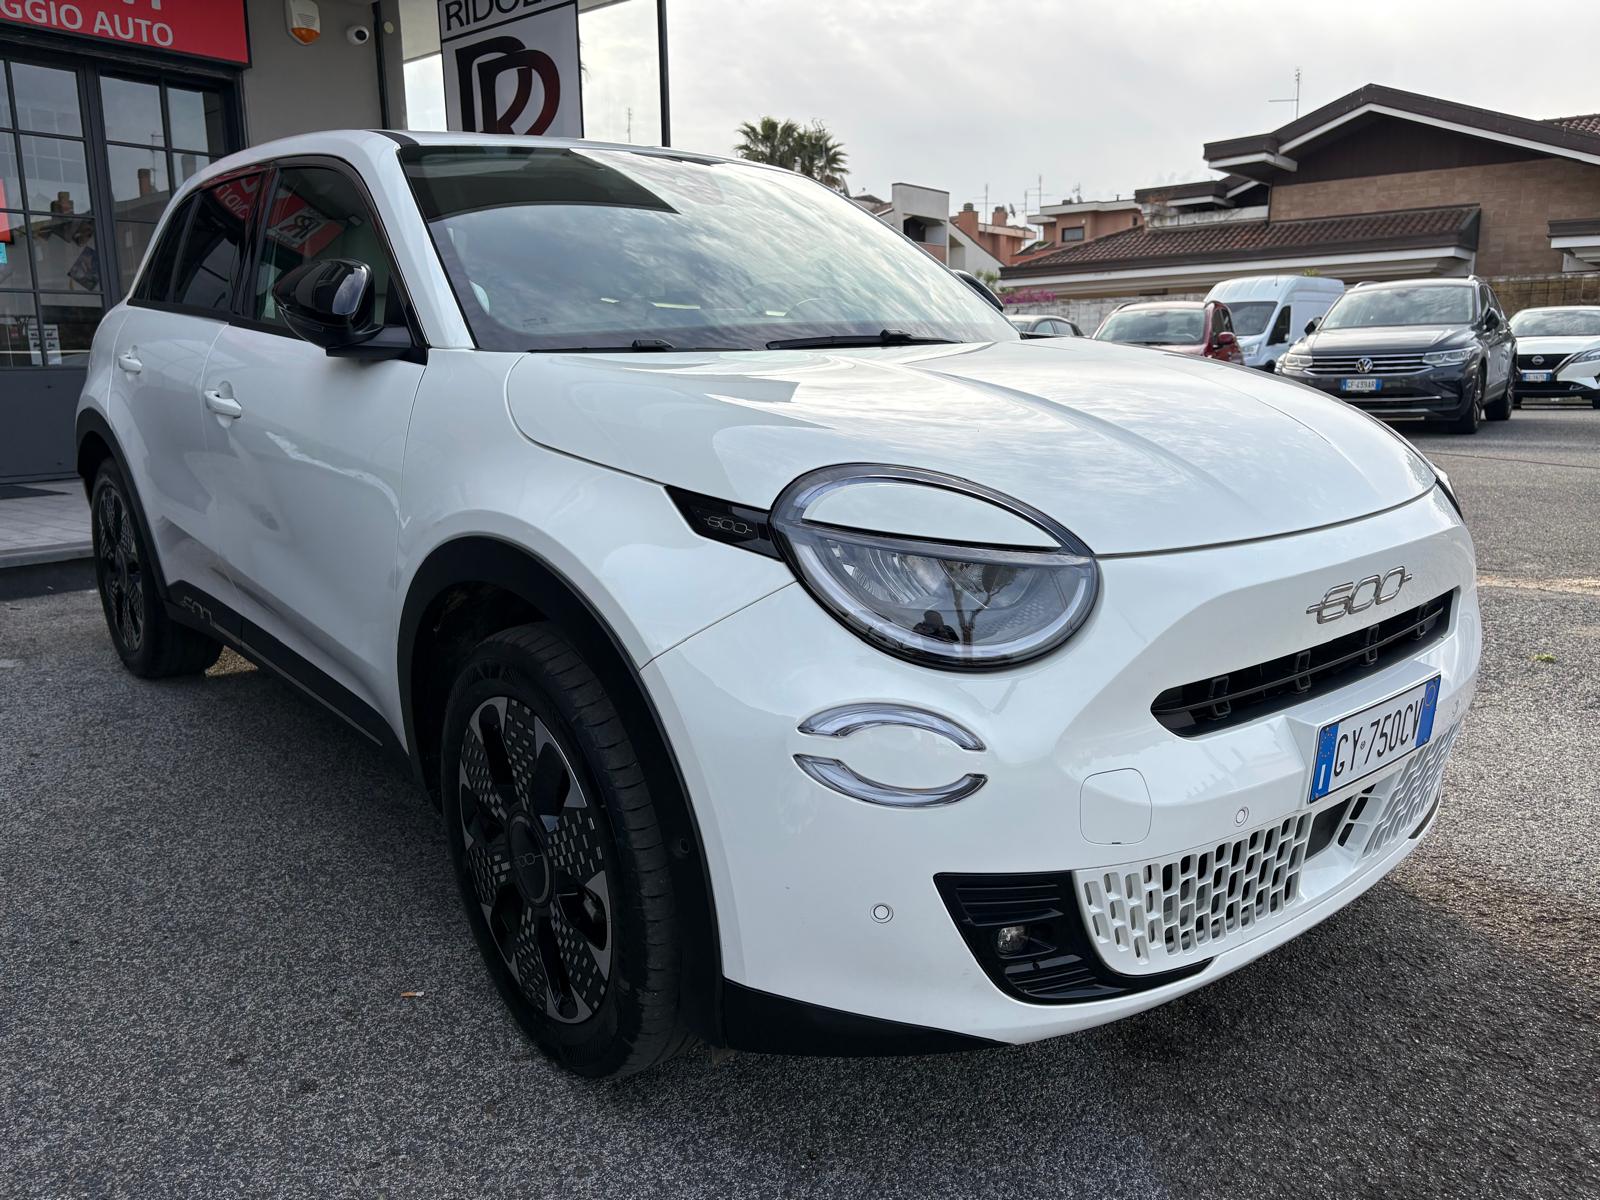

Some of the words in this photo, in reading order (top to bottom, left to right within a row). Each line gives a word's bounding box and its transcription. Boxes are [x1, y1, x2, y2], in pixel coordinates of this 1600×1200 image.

[93, 11, 174, 47] AUTO
[704, 516, 753, 535] 600
[1306, 565, 1413, 625] 600
